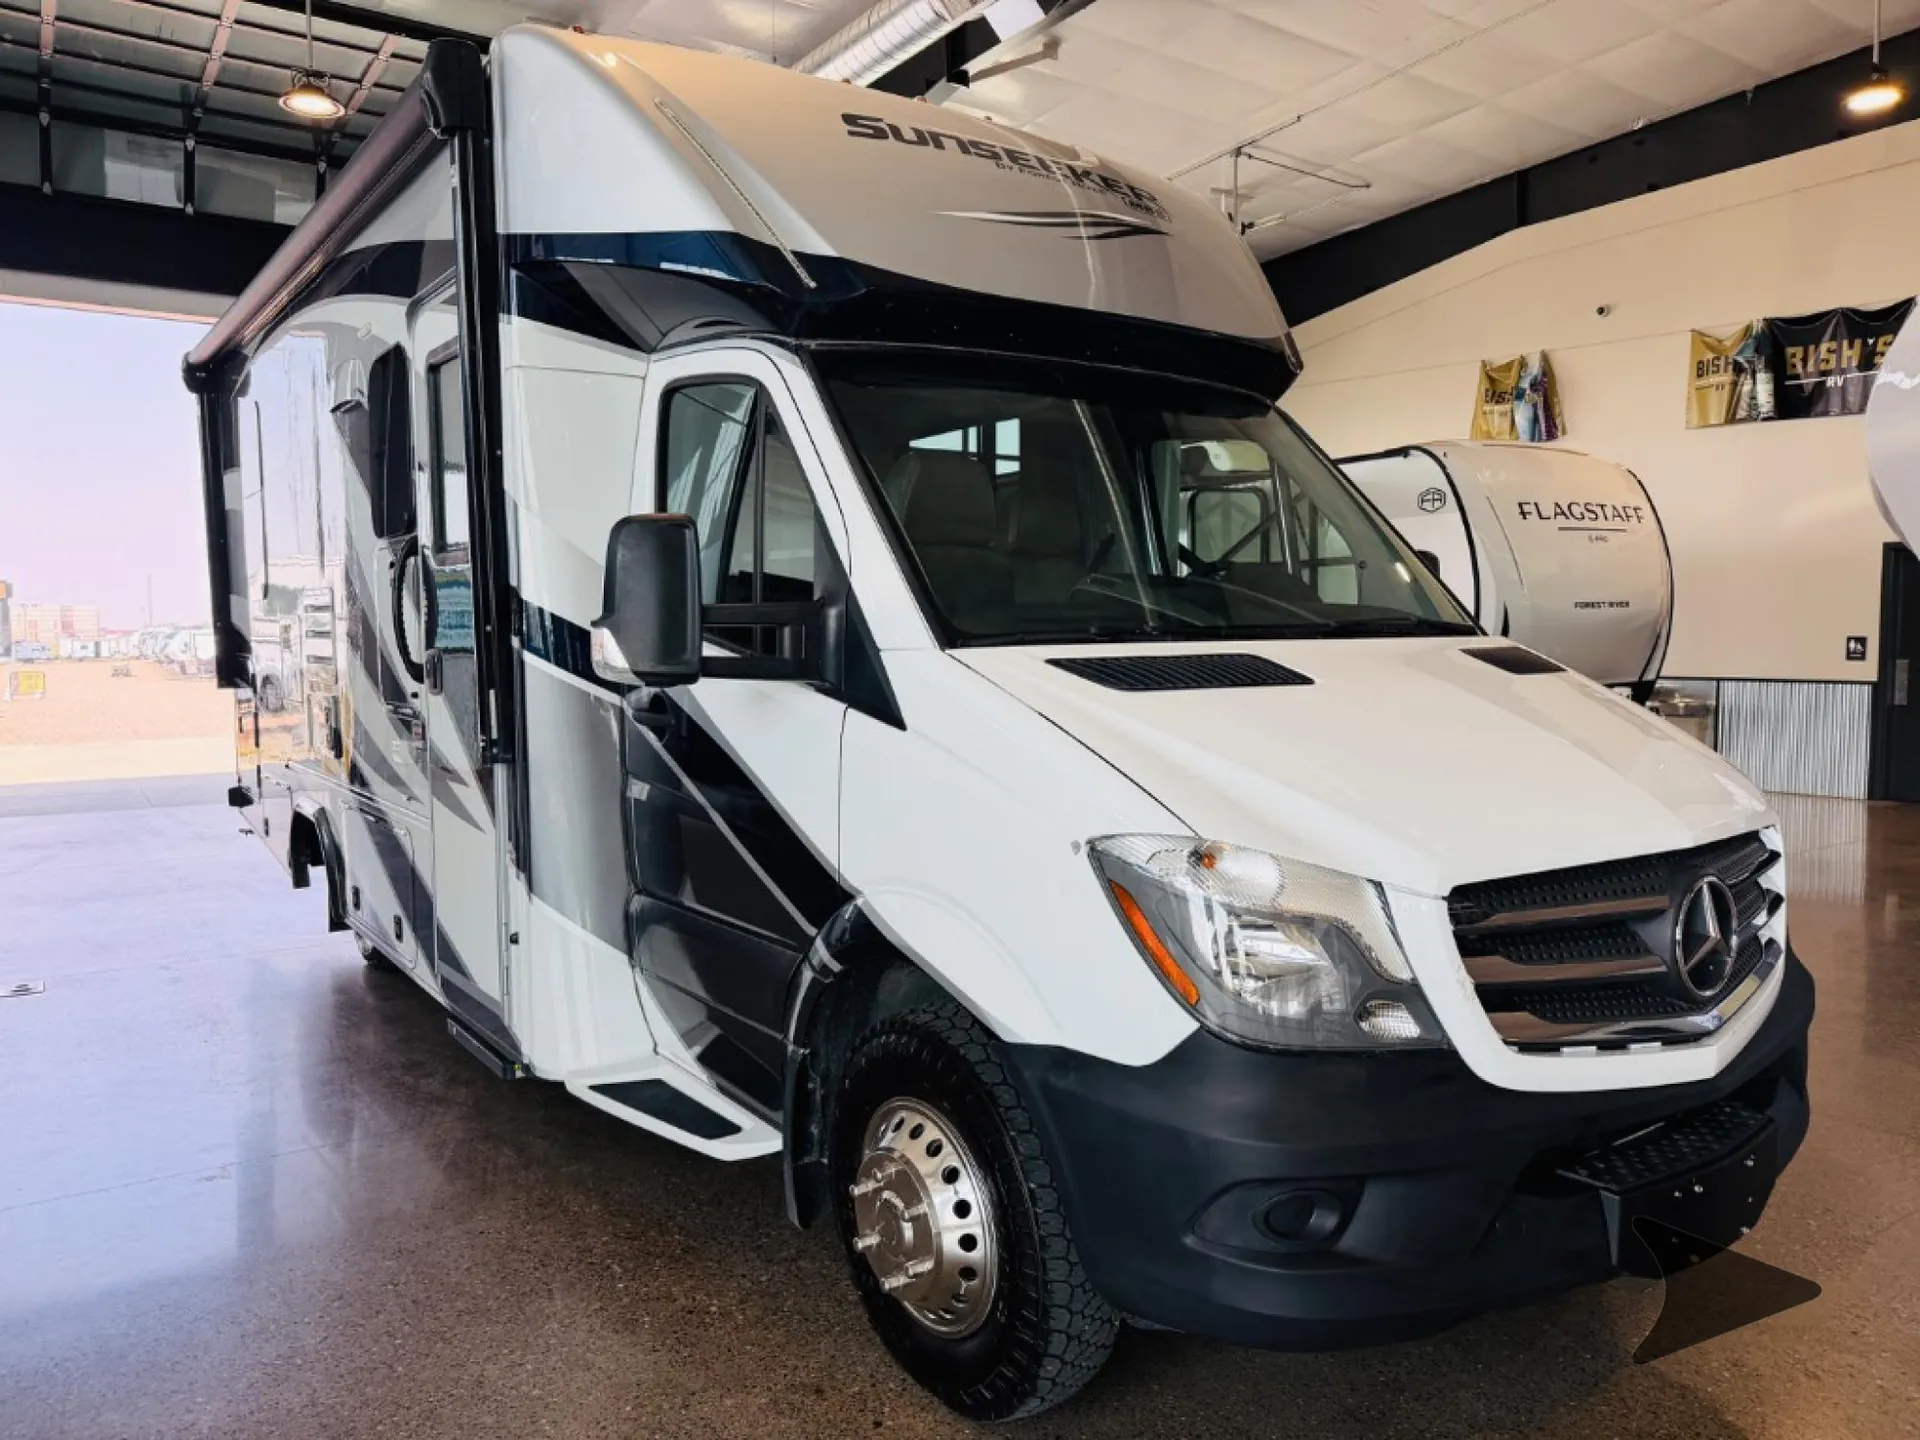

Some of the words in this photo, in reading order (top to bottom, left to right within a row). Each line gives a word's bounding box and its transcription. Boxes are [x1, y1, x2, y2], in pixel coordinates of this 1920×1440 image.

[1826, 375, 1844, 387] RV
[1517, 501, 1644, 523] FLAGSTAFF
[1574, 601, 1606, 609] FOREST
